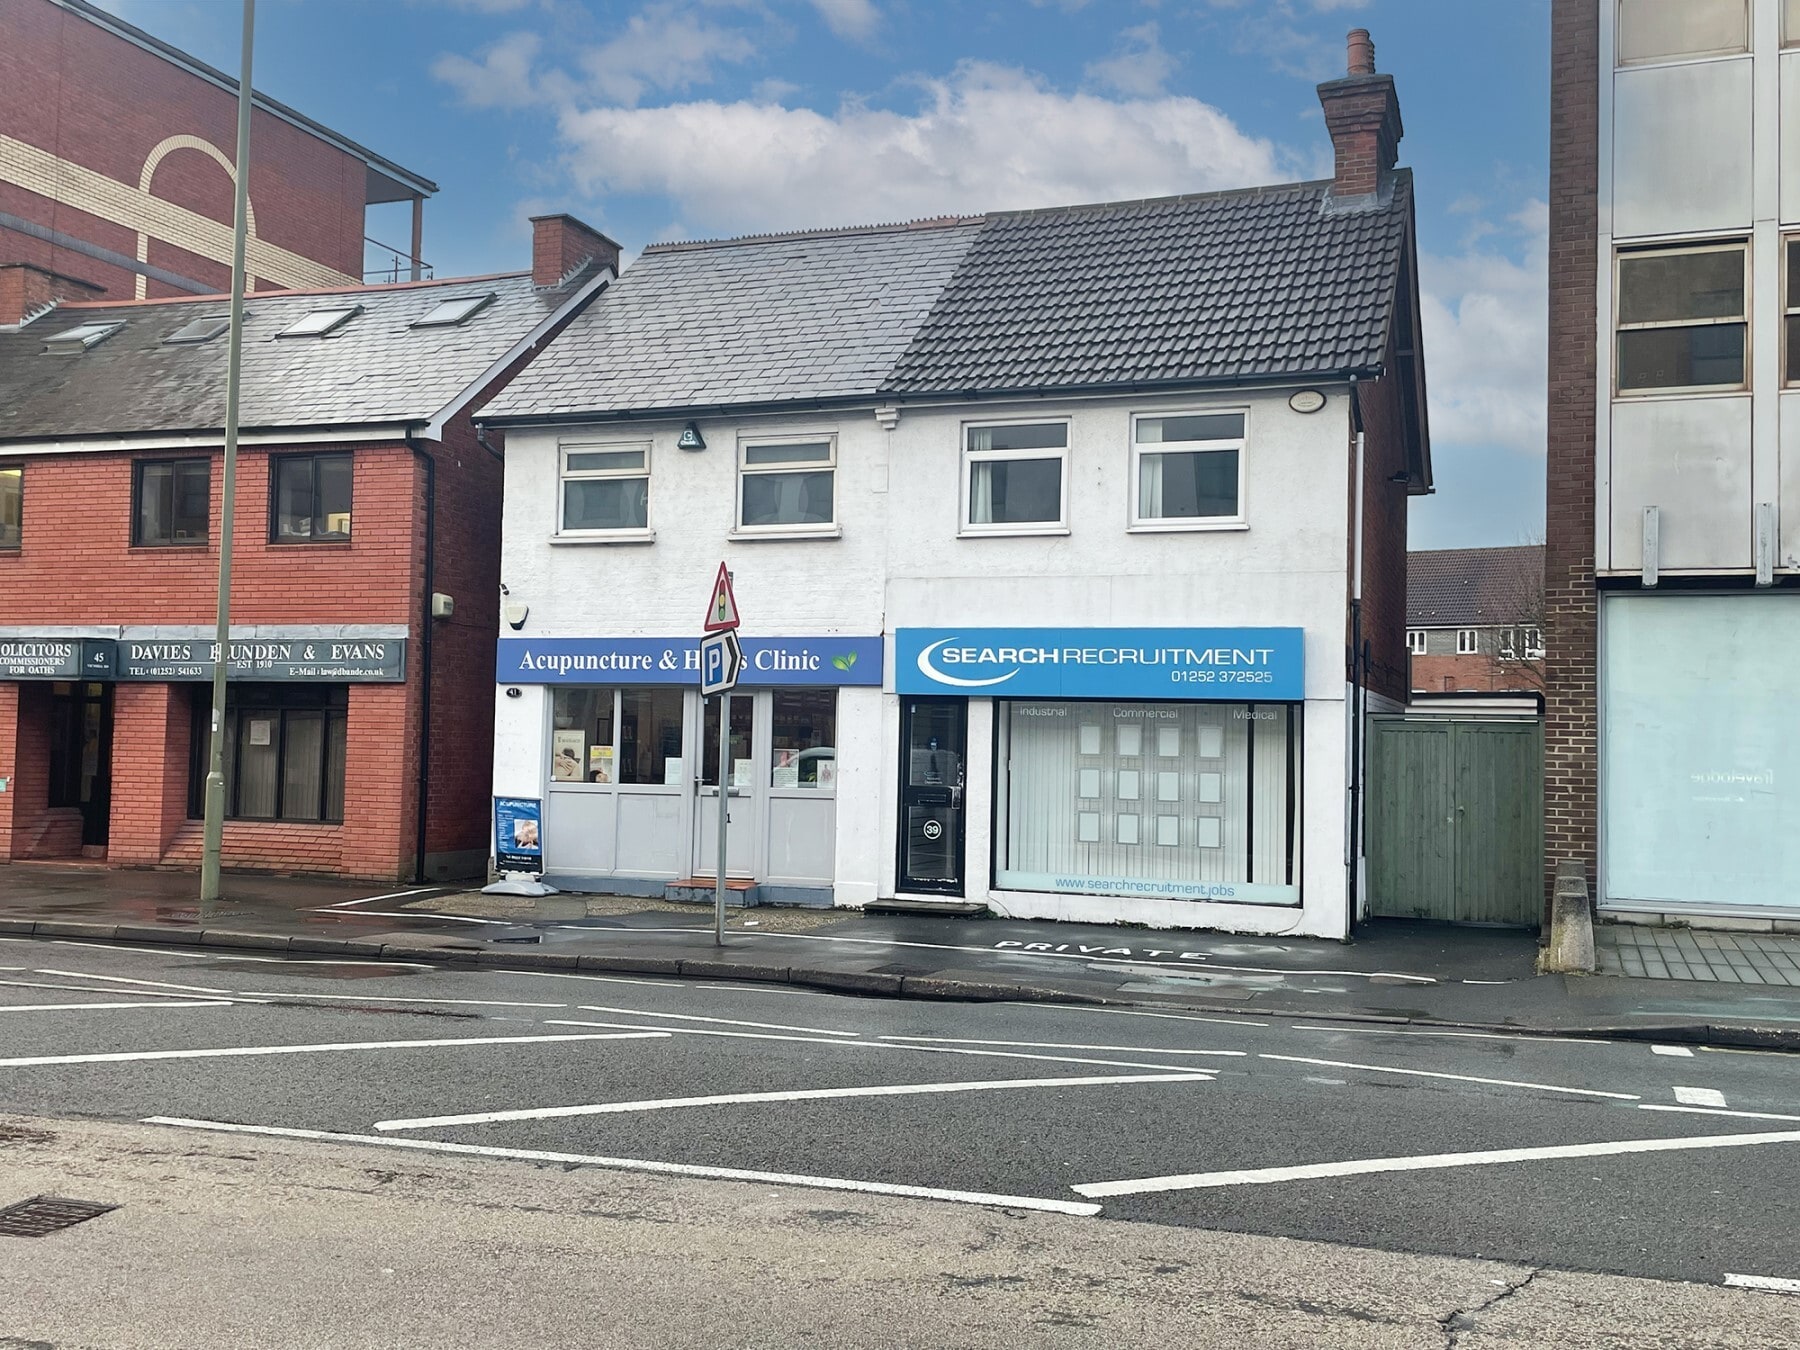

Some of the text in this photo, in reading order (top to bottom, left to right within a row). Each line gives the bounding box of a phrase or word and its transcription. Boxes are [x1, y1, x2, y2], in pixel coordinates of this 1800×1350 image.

[0, 643, 72, 657] OLICITORS
[131, 644, 191, 660] DAVIES
[303, 645, 316, 660] &
[331, 644, 385, 660] EVANS
[0, 657, 65, 666] COMMISSIONERS
[93, 652, 105, 663] 45
[518, 650, 653, 676] Acupuncture
[658, 649, 678, 670] &
[754, 649, 820, 671] Clinic
[9, 666, 55, 675] FOR OATHS
[236, 660, 273, 669] EST 1910
[1171, 670, 1273, 683] 01252 372525
[1020, 706, 1067, 717] Industrial
[1113, 707, 1178, 719] Commercial
[1233, 709, 1277, 721] Medical
[926, 825, 939, 835] 39
[1055, 877, 1235, 899] www.searchrecruitment.jobs
[994, 940, 1213, 960] PRIVATE
